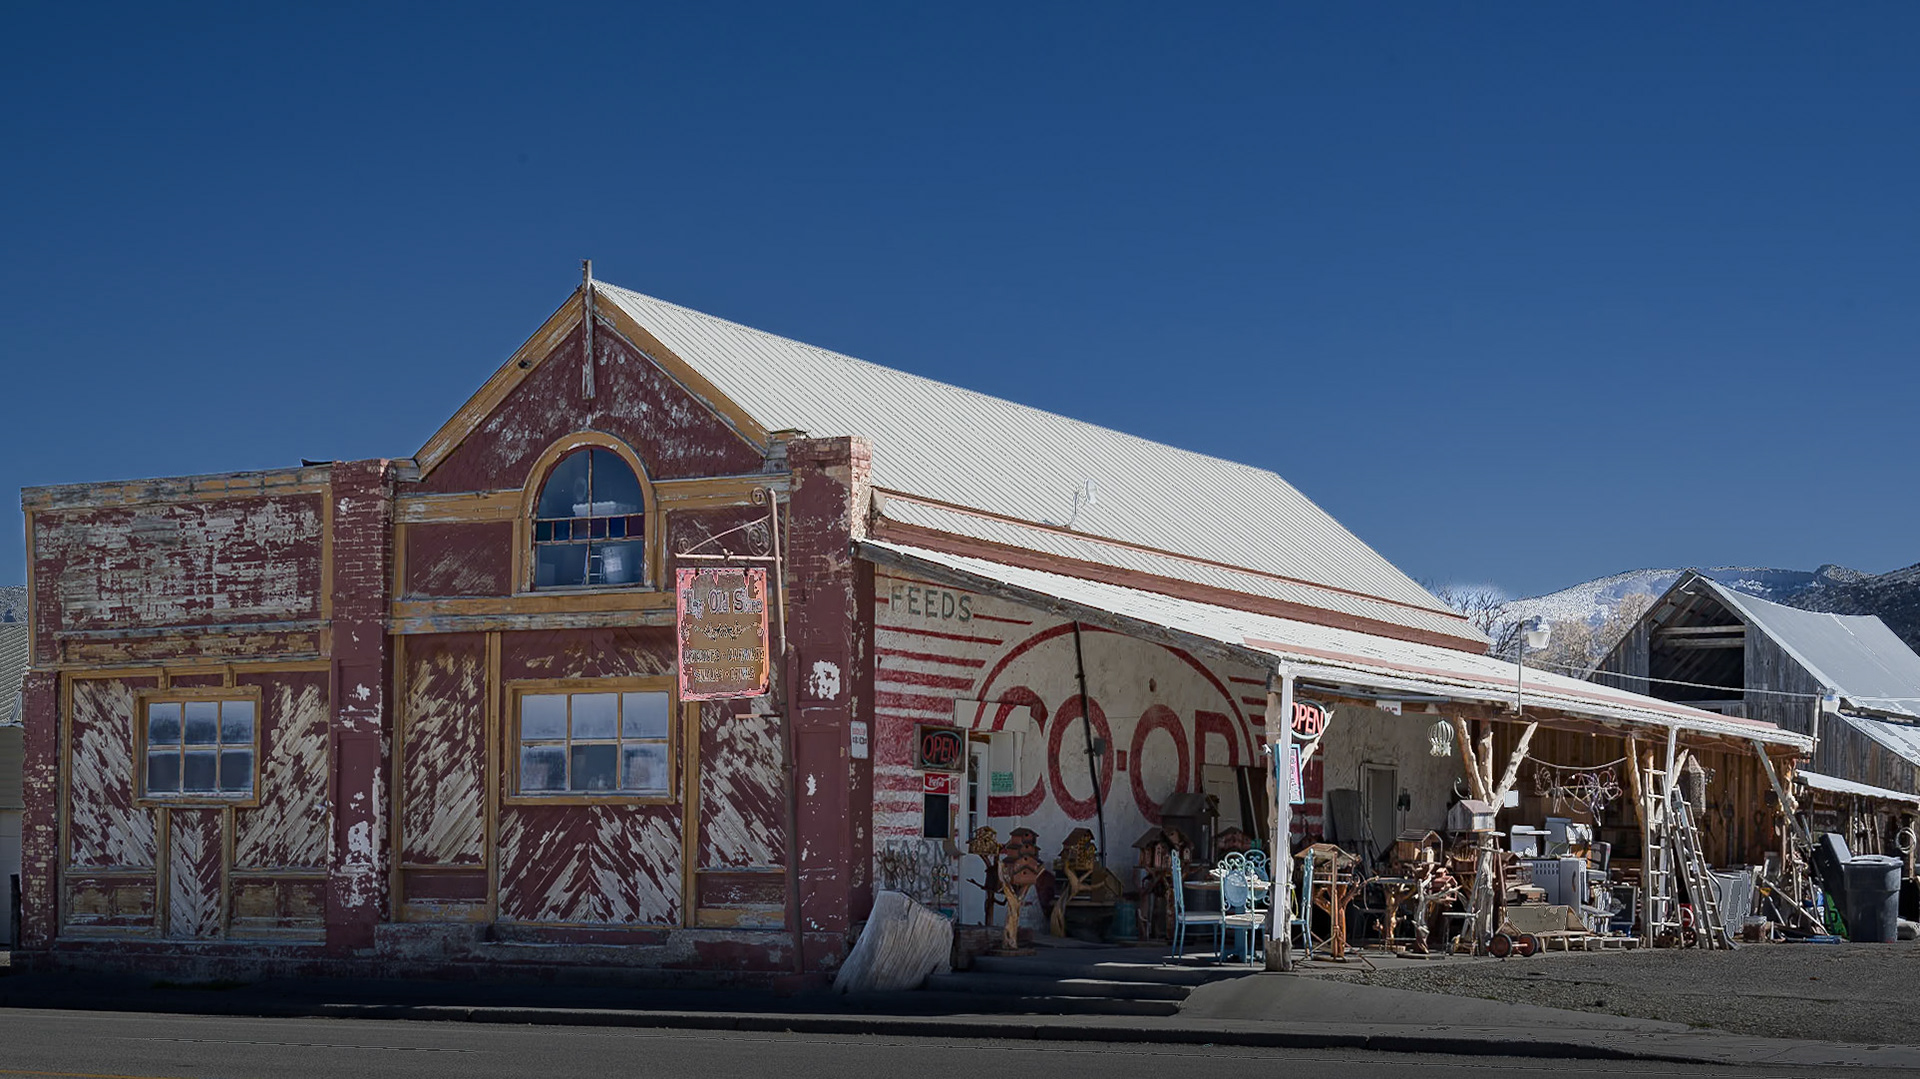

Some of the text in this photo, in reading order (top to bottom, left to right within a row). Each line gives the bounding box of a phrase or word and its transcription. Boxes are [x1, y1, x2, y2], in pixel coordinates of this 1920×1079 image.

[891, 585, 971, 622] FEEDS
[923, 734, 959, 763] OPEN
[988, 685, 1239, 826] CO-OP
